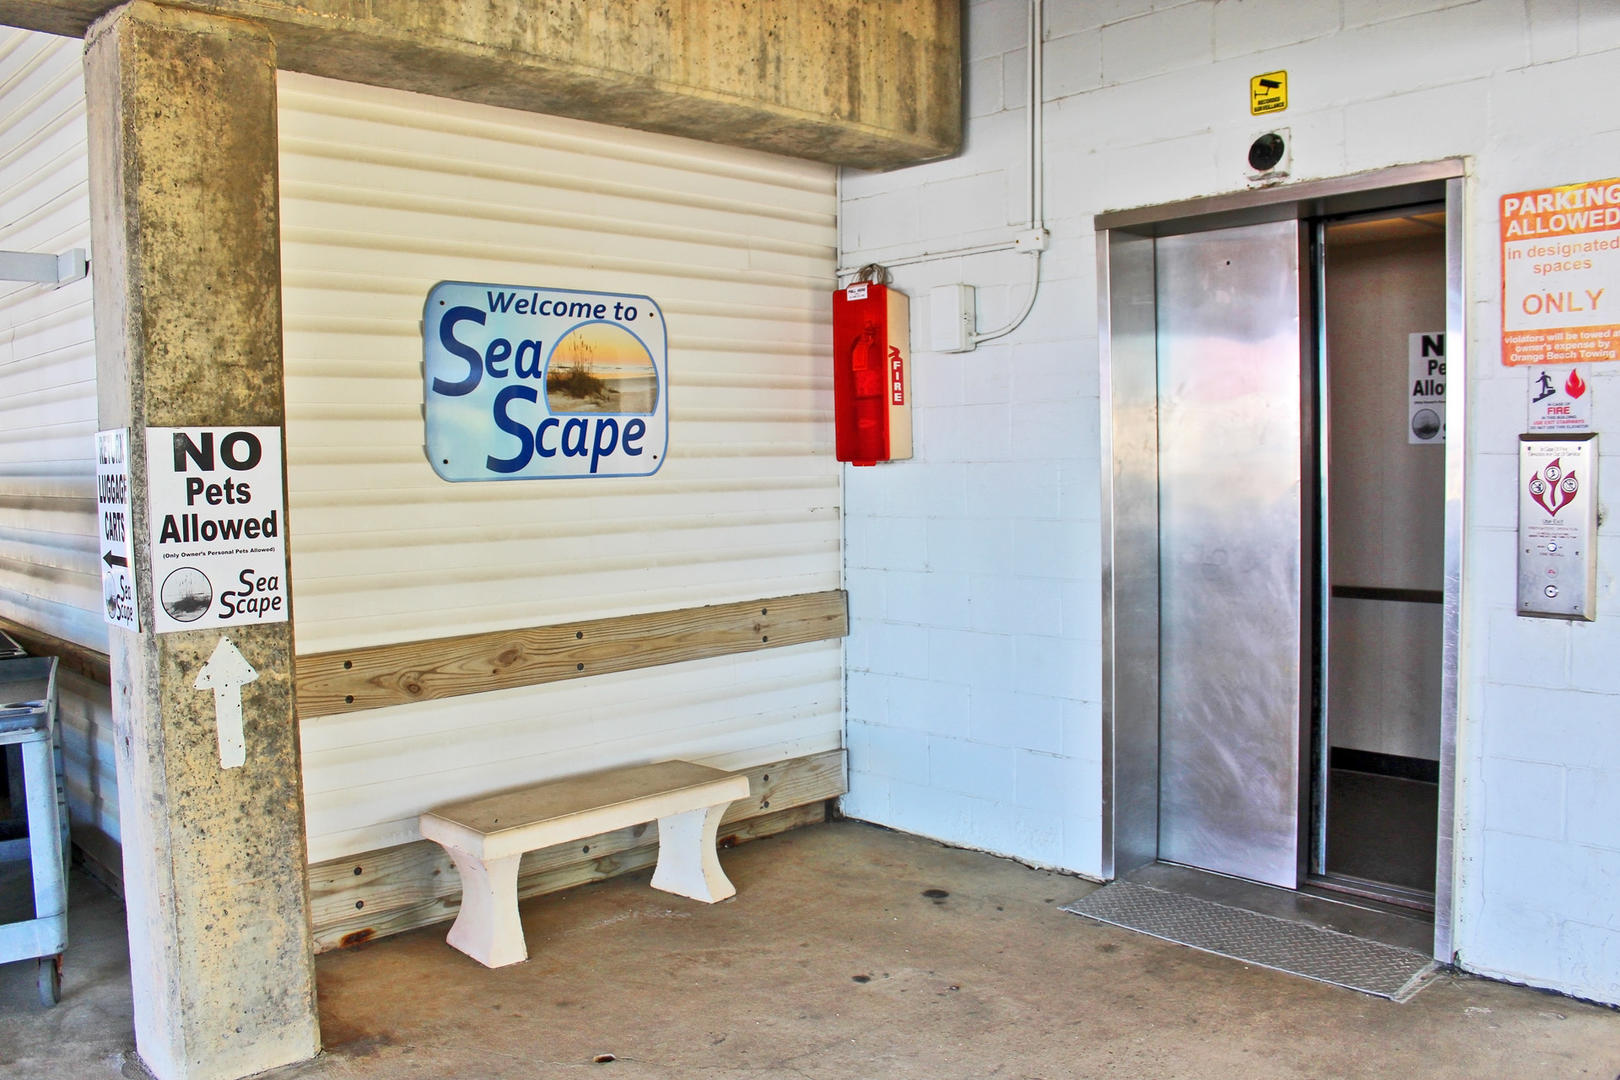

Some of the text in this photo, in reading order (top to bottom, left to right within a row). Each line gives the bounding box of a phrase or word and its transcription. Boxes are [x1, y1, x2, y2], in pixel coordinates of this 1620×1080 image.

[1504, 184, 1620, 218] PARKING
[1506, 207, 1620, 237] ALLOWED
[1508, 236, 1620, 260] in designated
[1533, 259, 1592, 276] spaces
[487, 291, 638, 321] Welcome to
[1522, 288, 1605, 316] ONLY
[1421, 334, 1446, 357] N
[1515, 339, 1610, 352] owner's expense by
[1546, 332, 1563, 341] will
[1580, 329, 1611, 339] towed
[432, 305, 543, 397] Sea
[1510, 348, 1616, 362] Orange Beach Towing
[893, 361, 902, 402] FIRE
[1428, 359, 1446, 376] Pe
[1413, 379, 1446, 396] Allo
[1547, 406, 1570, 415] FIRE
[486, 384, 646, 474] Scape
[173, 431, 262, 472] NO
[98, 474, 128, 504] LUGGAGE
[186, 476, 251, 506] Pets
[105, 511, 126, 542] CARTS
[159, 510, 278, 544] Allowed
[119, 574, 132, 602] Sea
[237, 569, 279, 597] Sea
[116, 594, 134, 626] Scape
[218, 591, 282, 619] Scape
